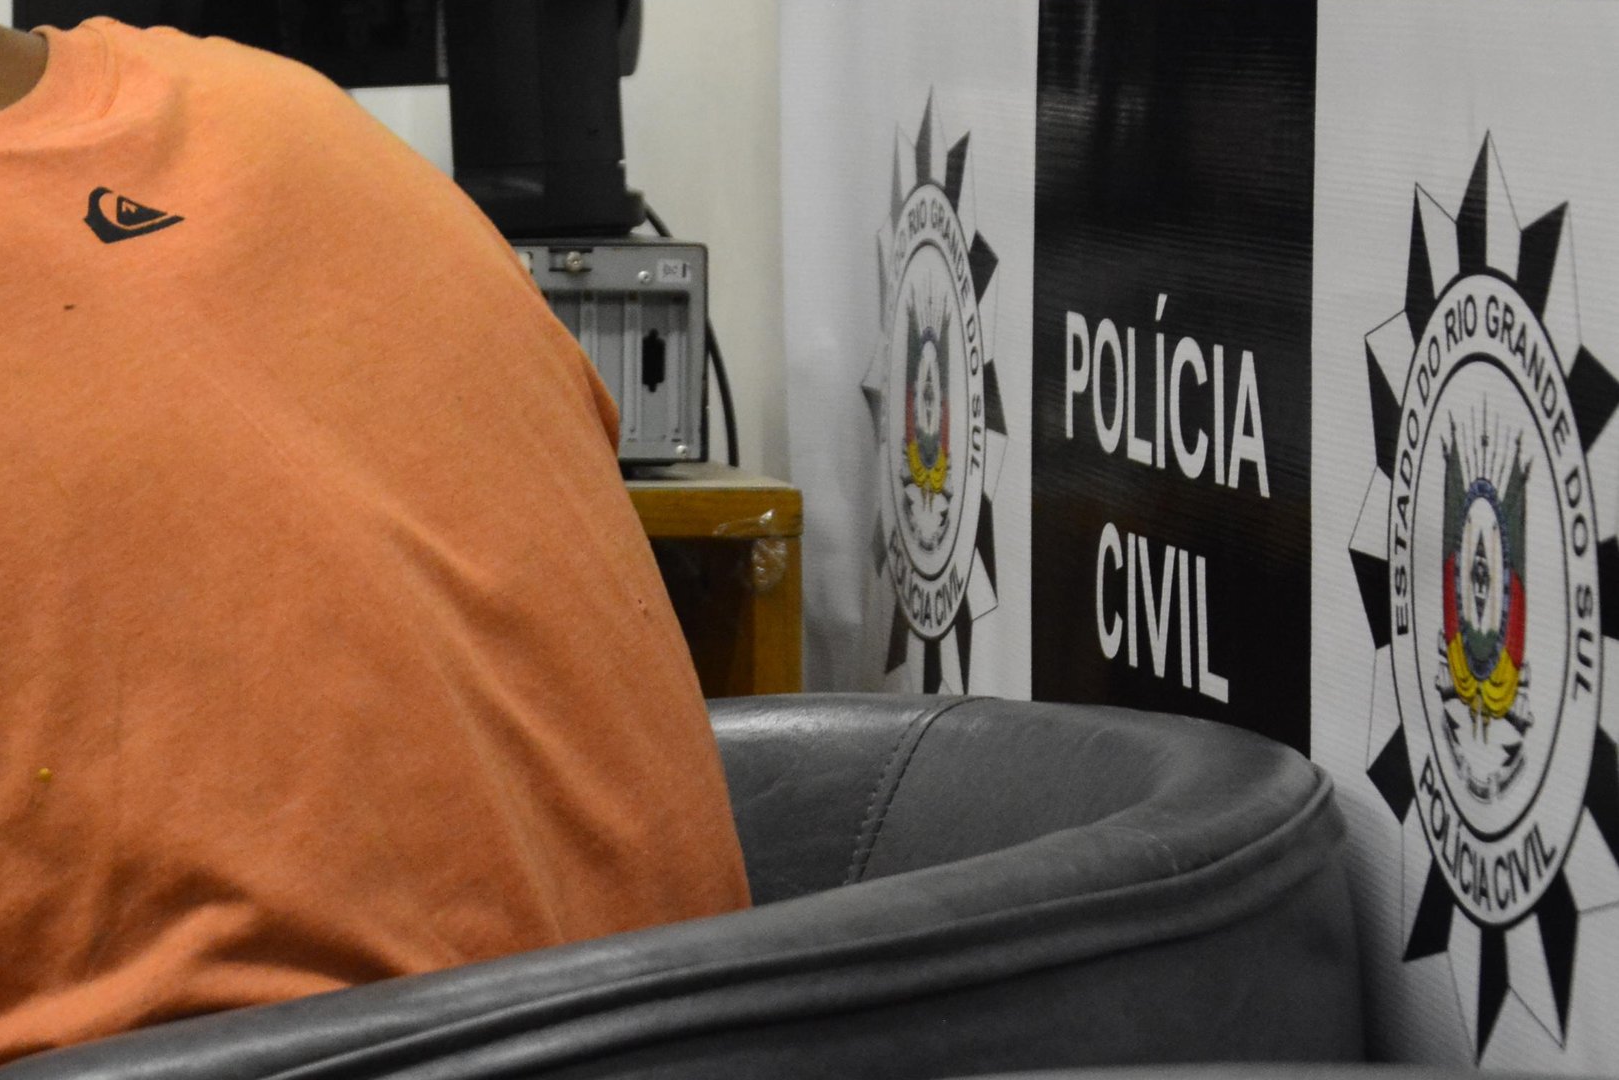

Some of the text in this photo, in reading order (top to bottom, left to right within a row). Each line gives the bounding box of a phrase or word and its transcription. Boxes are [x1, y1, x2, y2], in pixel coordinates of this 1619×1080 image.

[931, 197, 970, 308] GRANDE
[966, 313, 979, 376] DO
[1066, 293, 1270, 498] POLÍCIA
[970, 393, 982, 475] SUL
[1394, 294, 1594, 702] ESTADO DO RIO GRANDE DO SUL
[1096, 521, 1229, 704] CIVIL
[1419, 756, 1557, 912] POLÍCIA CIVIL
